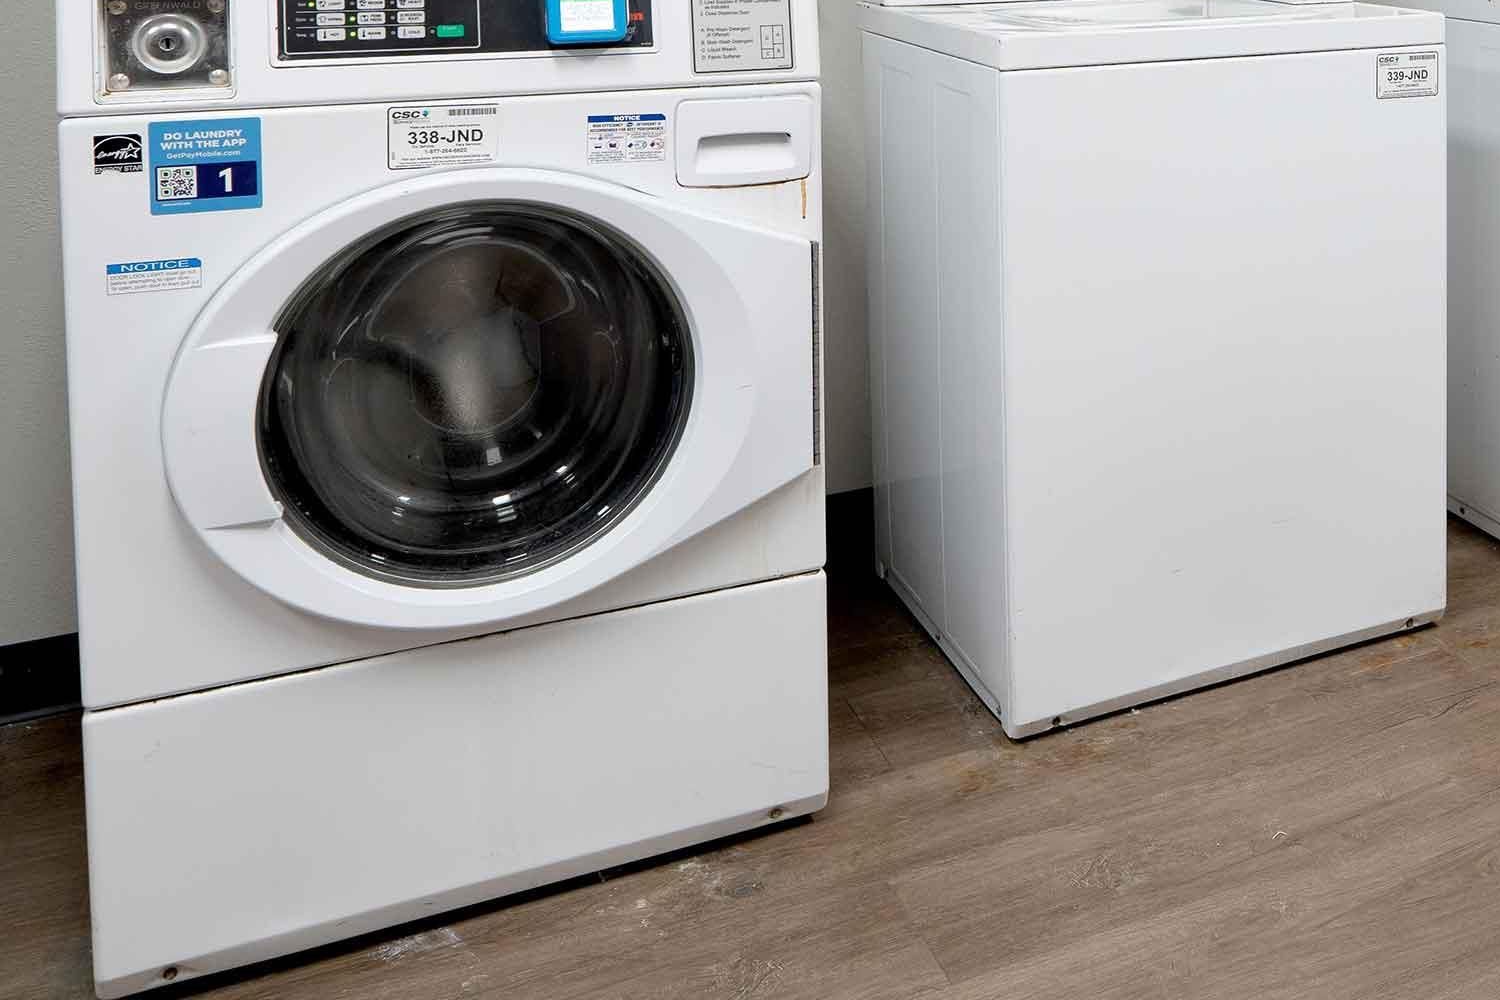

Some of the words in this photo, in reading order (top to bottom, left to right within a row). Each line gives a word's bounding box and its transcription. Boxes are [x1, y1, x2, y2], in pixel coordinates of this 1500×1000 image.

[1387, 69, 1429, 81] 339-JND
[391, 110, 421, 120] CSC
[163, 131, 182, 141] DO
[185, 129, 243, 140] LAUNDRY
[407, 128, 484, 145] 338-JND
[160, 140, 193, 151] WITH
[195, 139, 220, 149] THE
[222, 138, 247, 148] APP
[166, 149, 241, 161] GetPayMobile.com
[218, 167, 233, 193] 1
[120, 259, 189, 273] NOTICE
